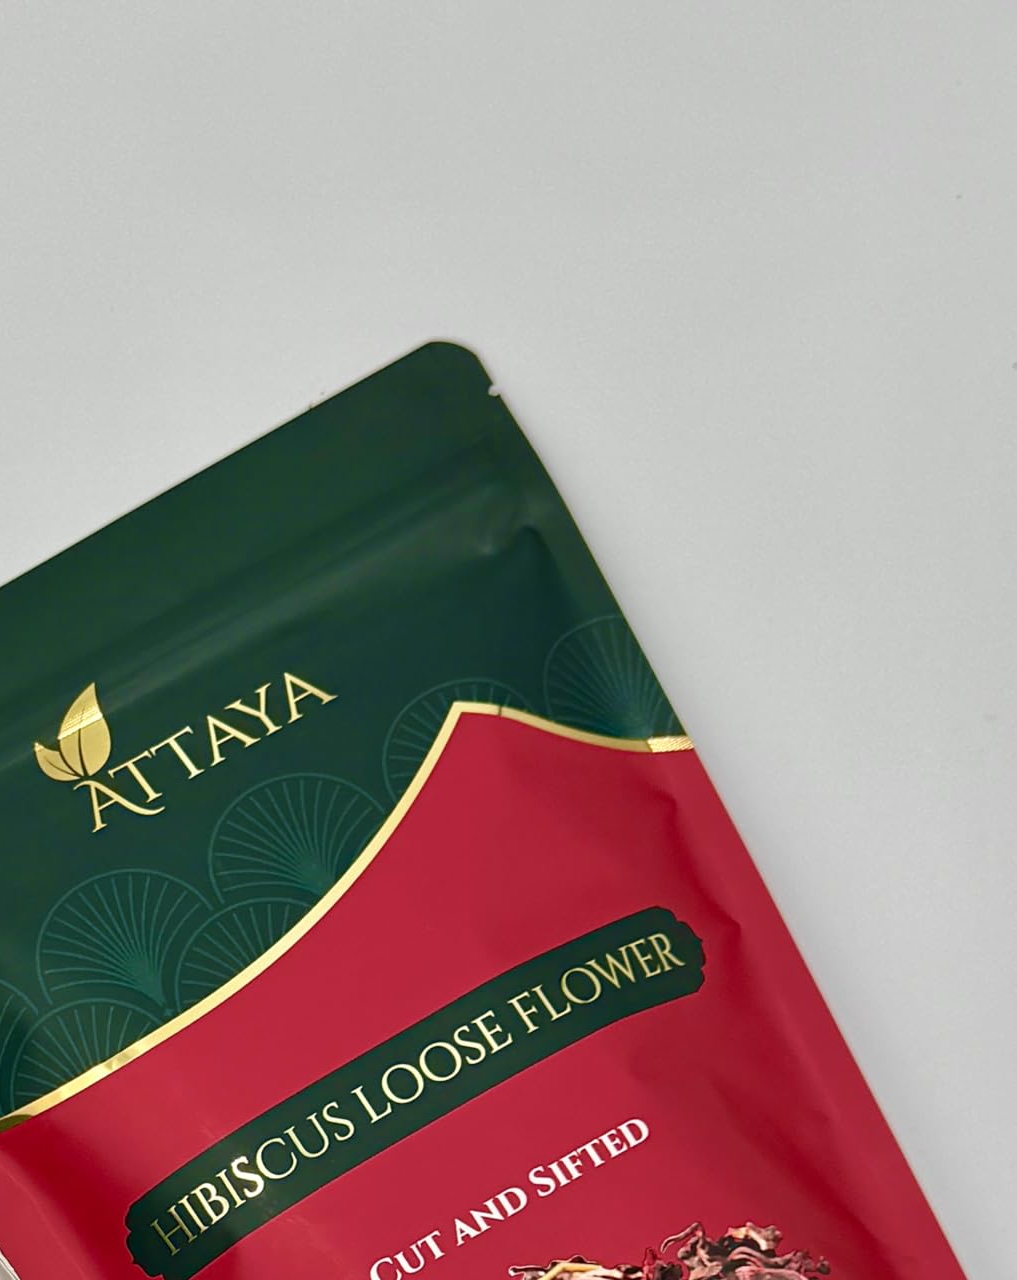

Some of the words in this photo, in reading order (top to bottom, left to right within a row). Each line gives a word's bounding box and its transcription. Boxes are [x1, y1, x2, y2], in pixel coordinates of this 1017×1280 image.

[73, 672, 338, 832] ATTAYA
[149, 1101, 355, 1256] HIBISCUS
[351, 1010, 513, 1124] LOOSE
[508, 932, 686, 1034] FLOWER
[453, 1184, 528, 1247] AND
[528, 1117, 651, 1199] SIFTED
